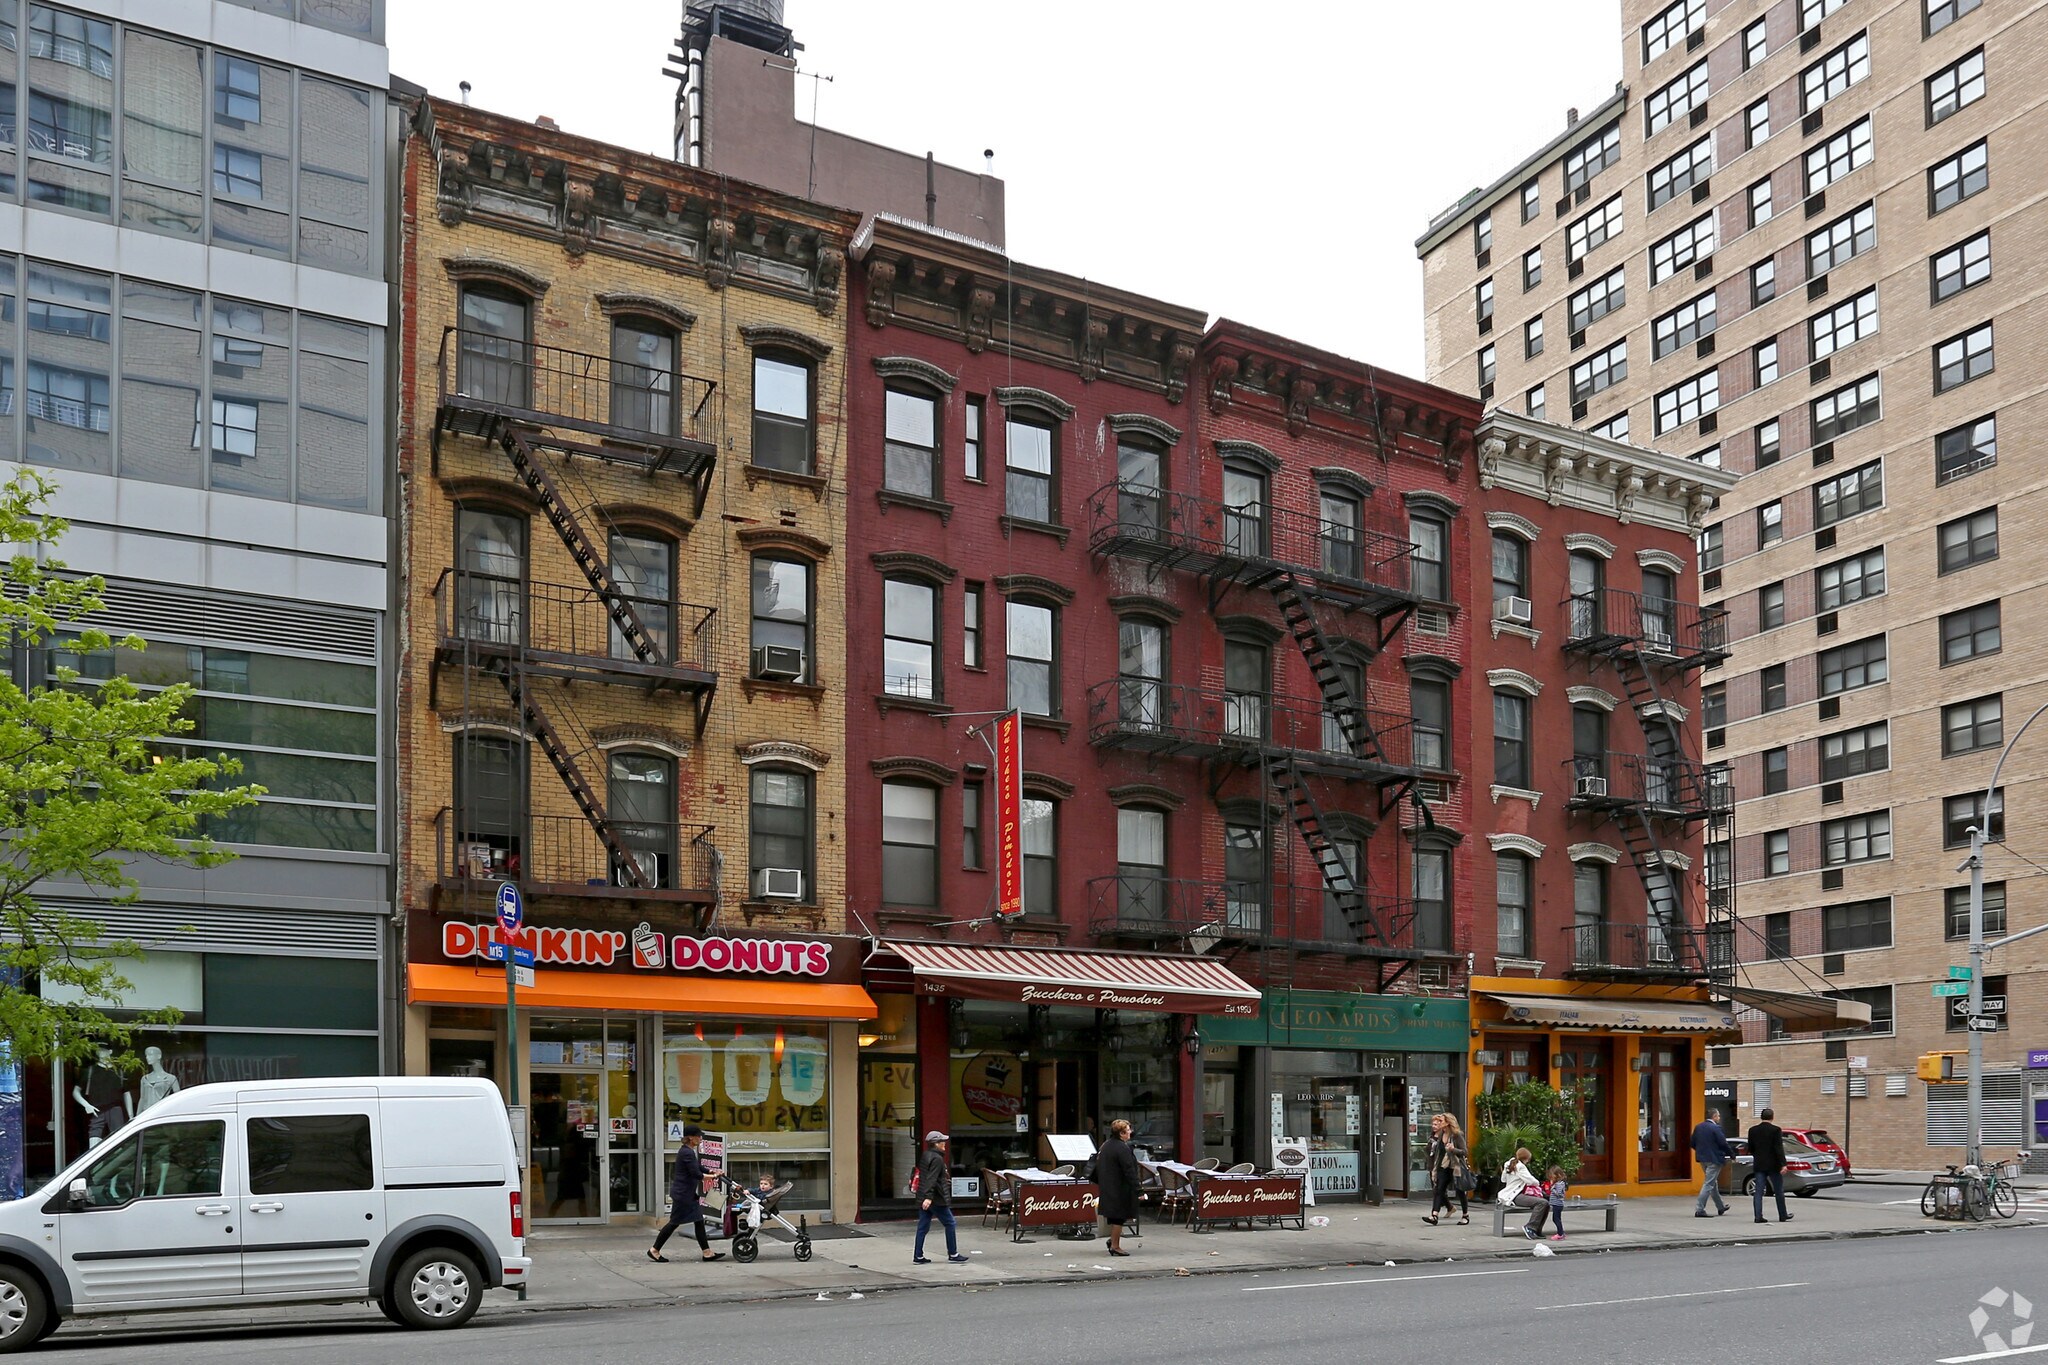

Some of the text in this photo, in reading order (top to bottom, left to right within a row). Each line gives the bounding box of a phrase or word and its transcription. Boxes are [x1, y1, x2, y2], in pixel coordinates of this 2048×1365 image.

[1003, 720, 1012, 800] Zucchero
[1004, 822, 1014, 896] Pomodori
[1010, 897, 1020, 909] 1990
[489, 945, 503, 958] M15
[674, 938, 828, 974] DONUTS
[924, 982, 945, 993] 1435
[1935, 985, 1941, 994] E
[1943, 985, 1958, 994] 75
[1022, 986, 1165, 1006] Zucchero e Pomodori
[1373, 1057, 1396, 1070] 1437
[1018, 1116, 1027, 1127] A
[671, 1123, 681, 1136] A
[727, 1140, 770, 1149] CAPPUCCINO
[1327, 1176, 1356, 1190] CRABS
[1203, 1188, 1297, 1209] Zucchero e Pomodori
[1024, 1196, 1070, 1217] Zucchero
[1072, 1200, 1079, 1209] e
